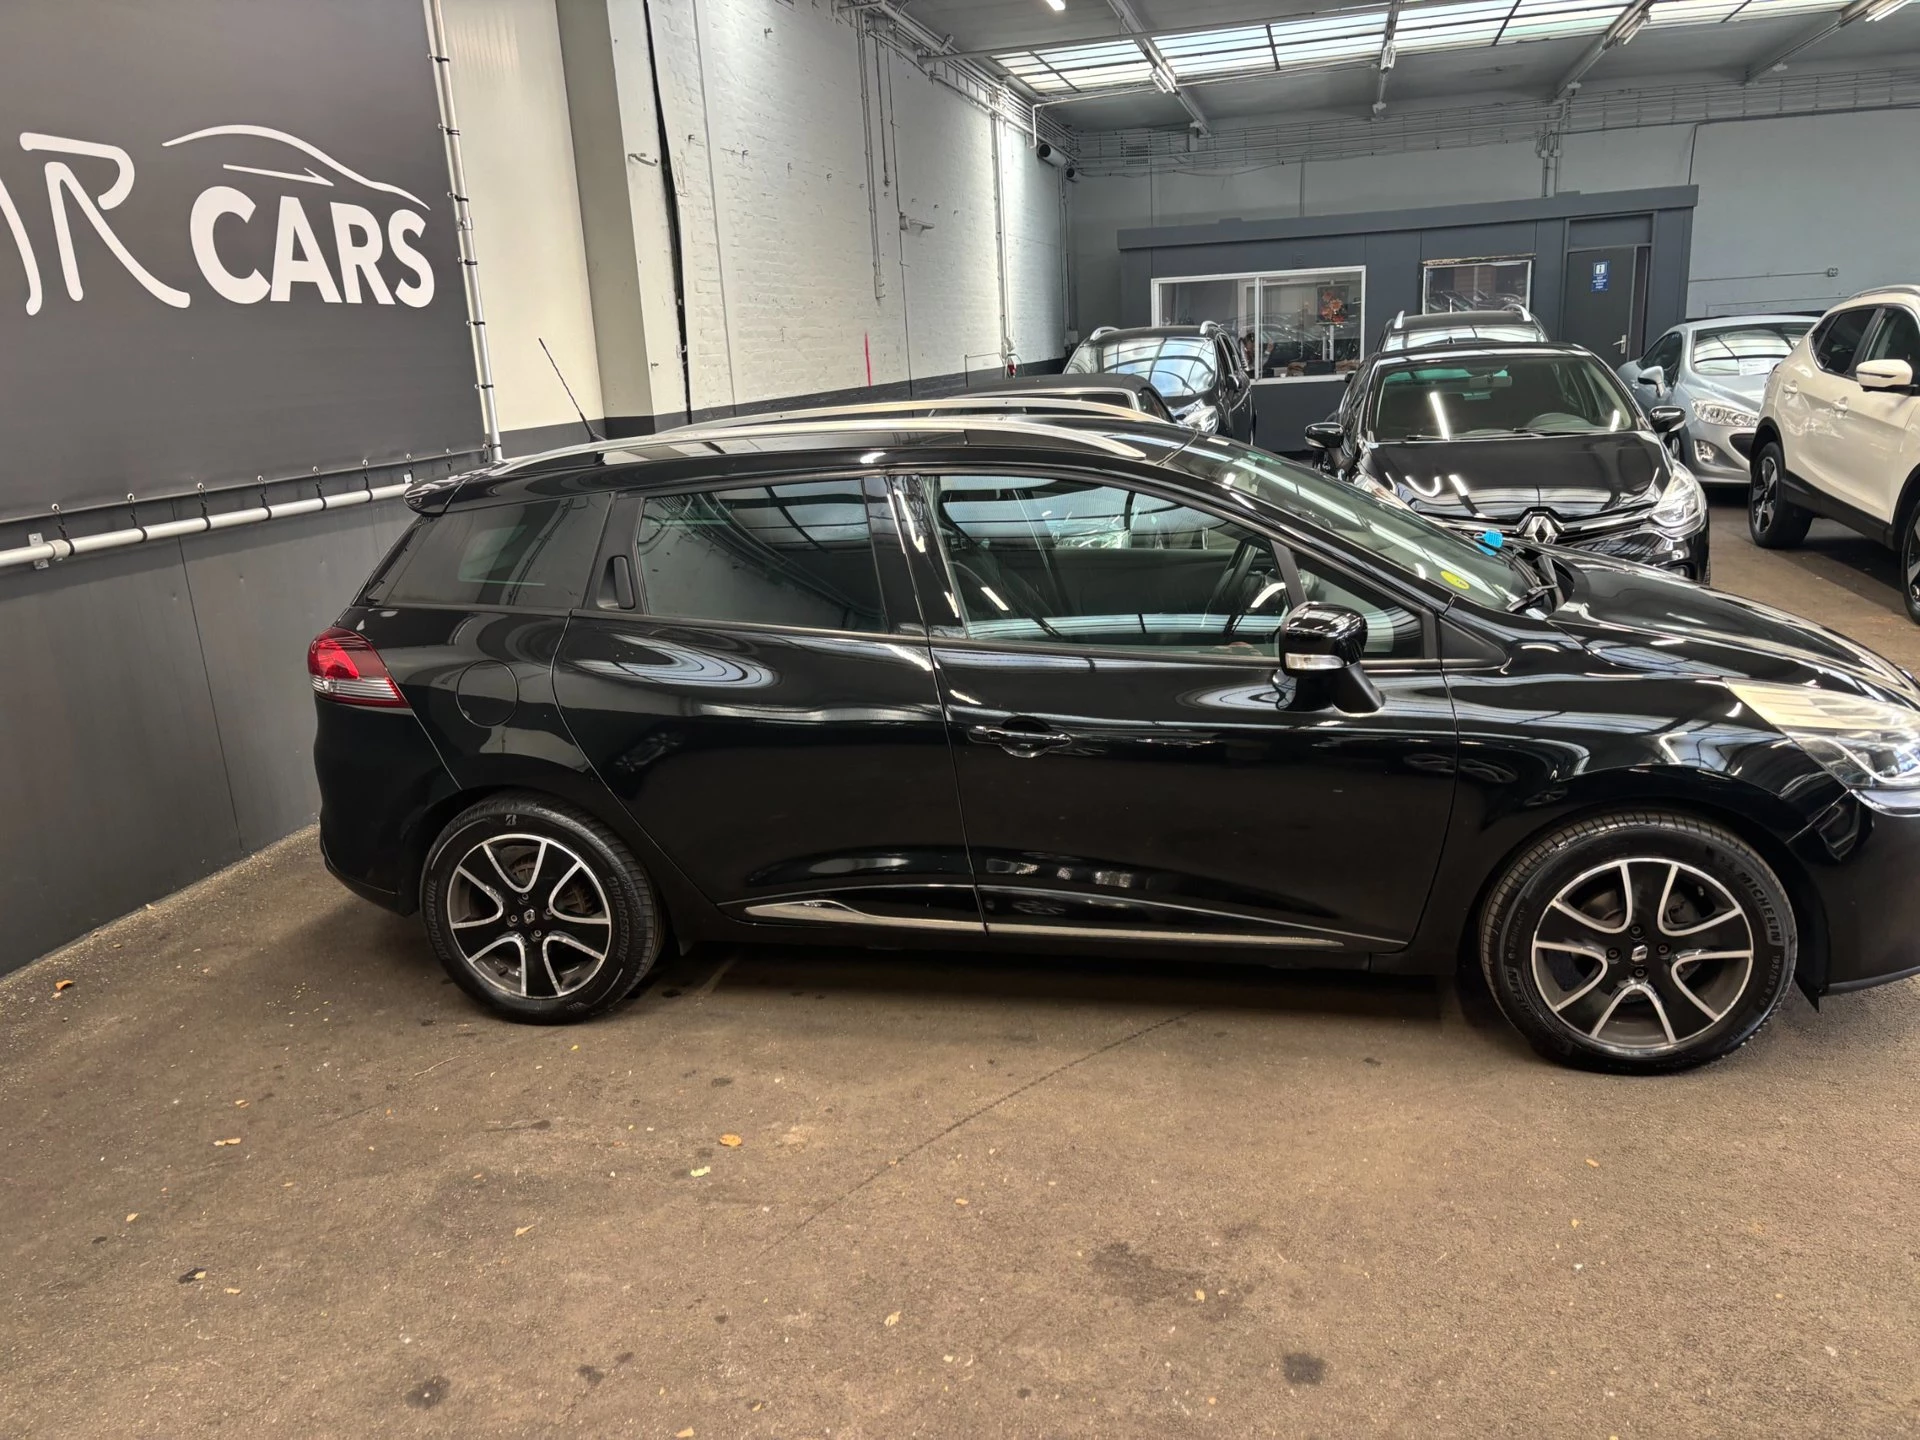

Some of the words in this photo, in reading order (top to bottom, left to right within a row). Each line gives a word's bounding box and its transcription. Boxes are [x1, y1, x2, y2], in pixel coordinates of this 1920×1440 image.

[190, 186, 435, 308] CARS
[425, 879, 451, 961] BRIDGESTONE
[606, 876, 630, 963] BRIDGESTONE
[1738, 871, 1781, 942] MICHELIN
